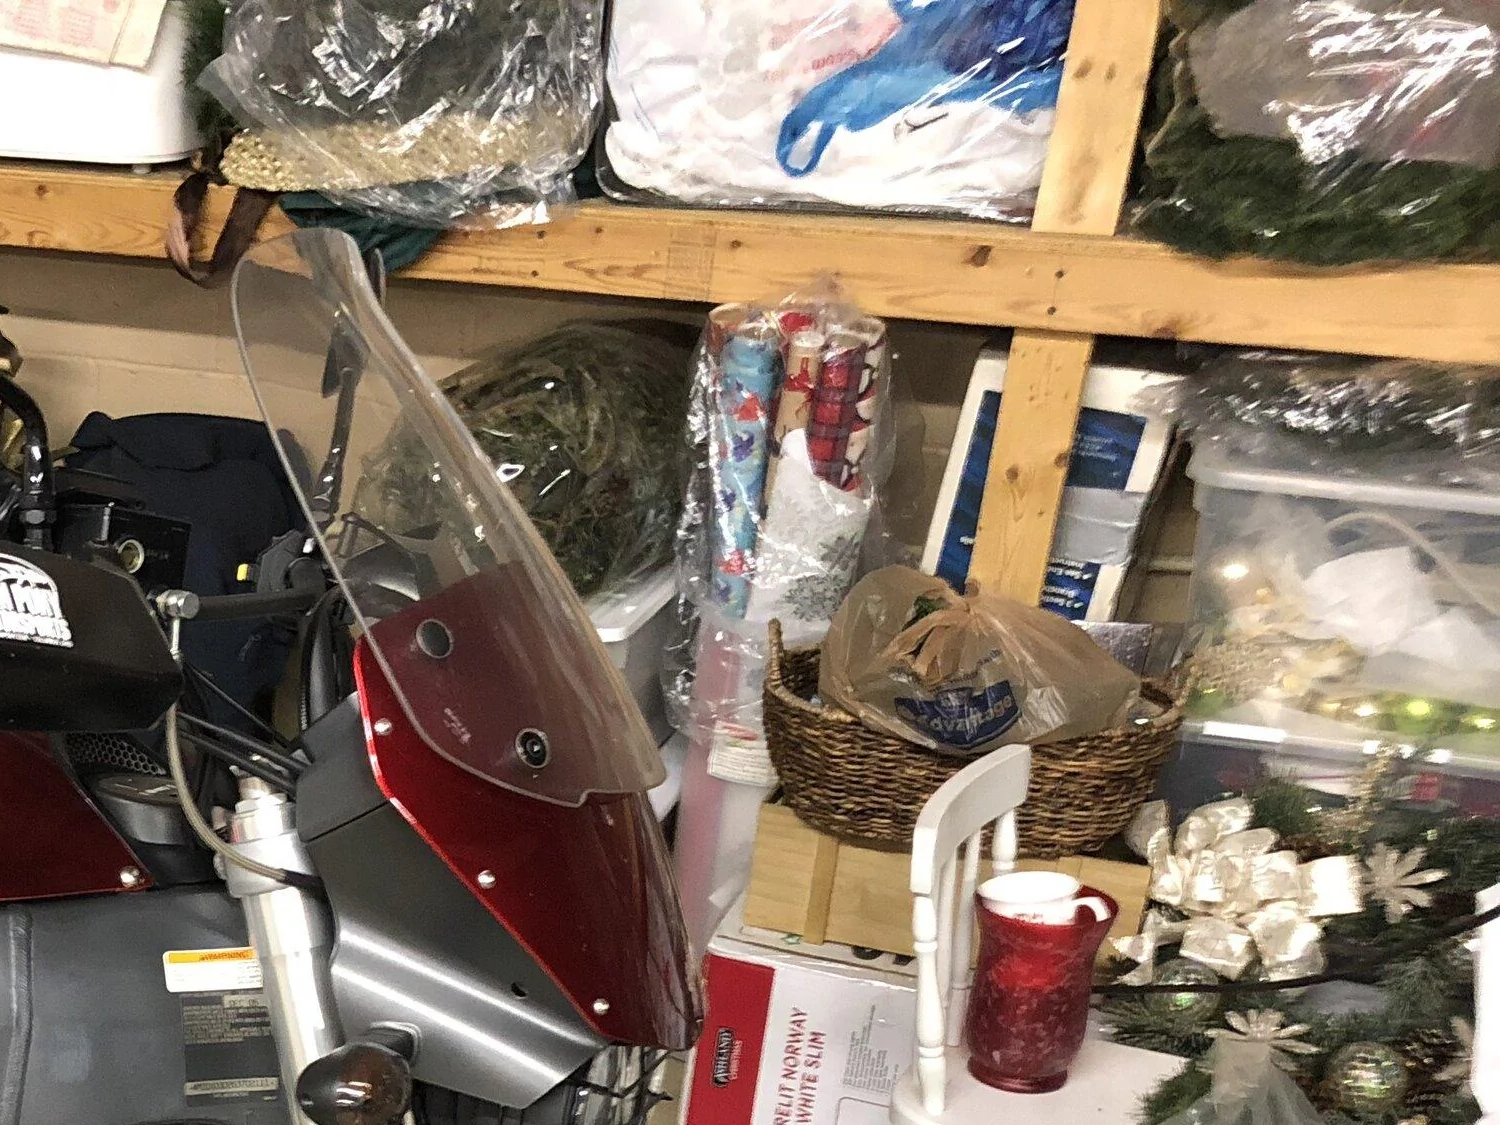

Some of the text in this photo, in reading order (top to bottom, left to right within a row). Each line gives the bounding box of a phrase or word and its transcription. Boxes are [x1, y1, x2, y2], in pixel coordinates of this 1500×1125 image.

[780, 1006, 809, 1081] NORWAY
[795, 1031, 827, 1124] WHITE SLIM
